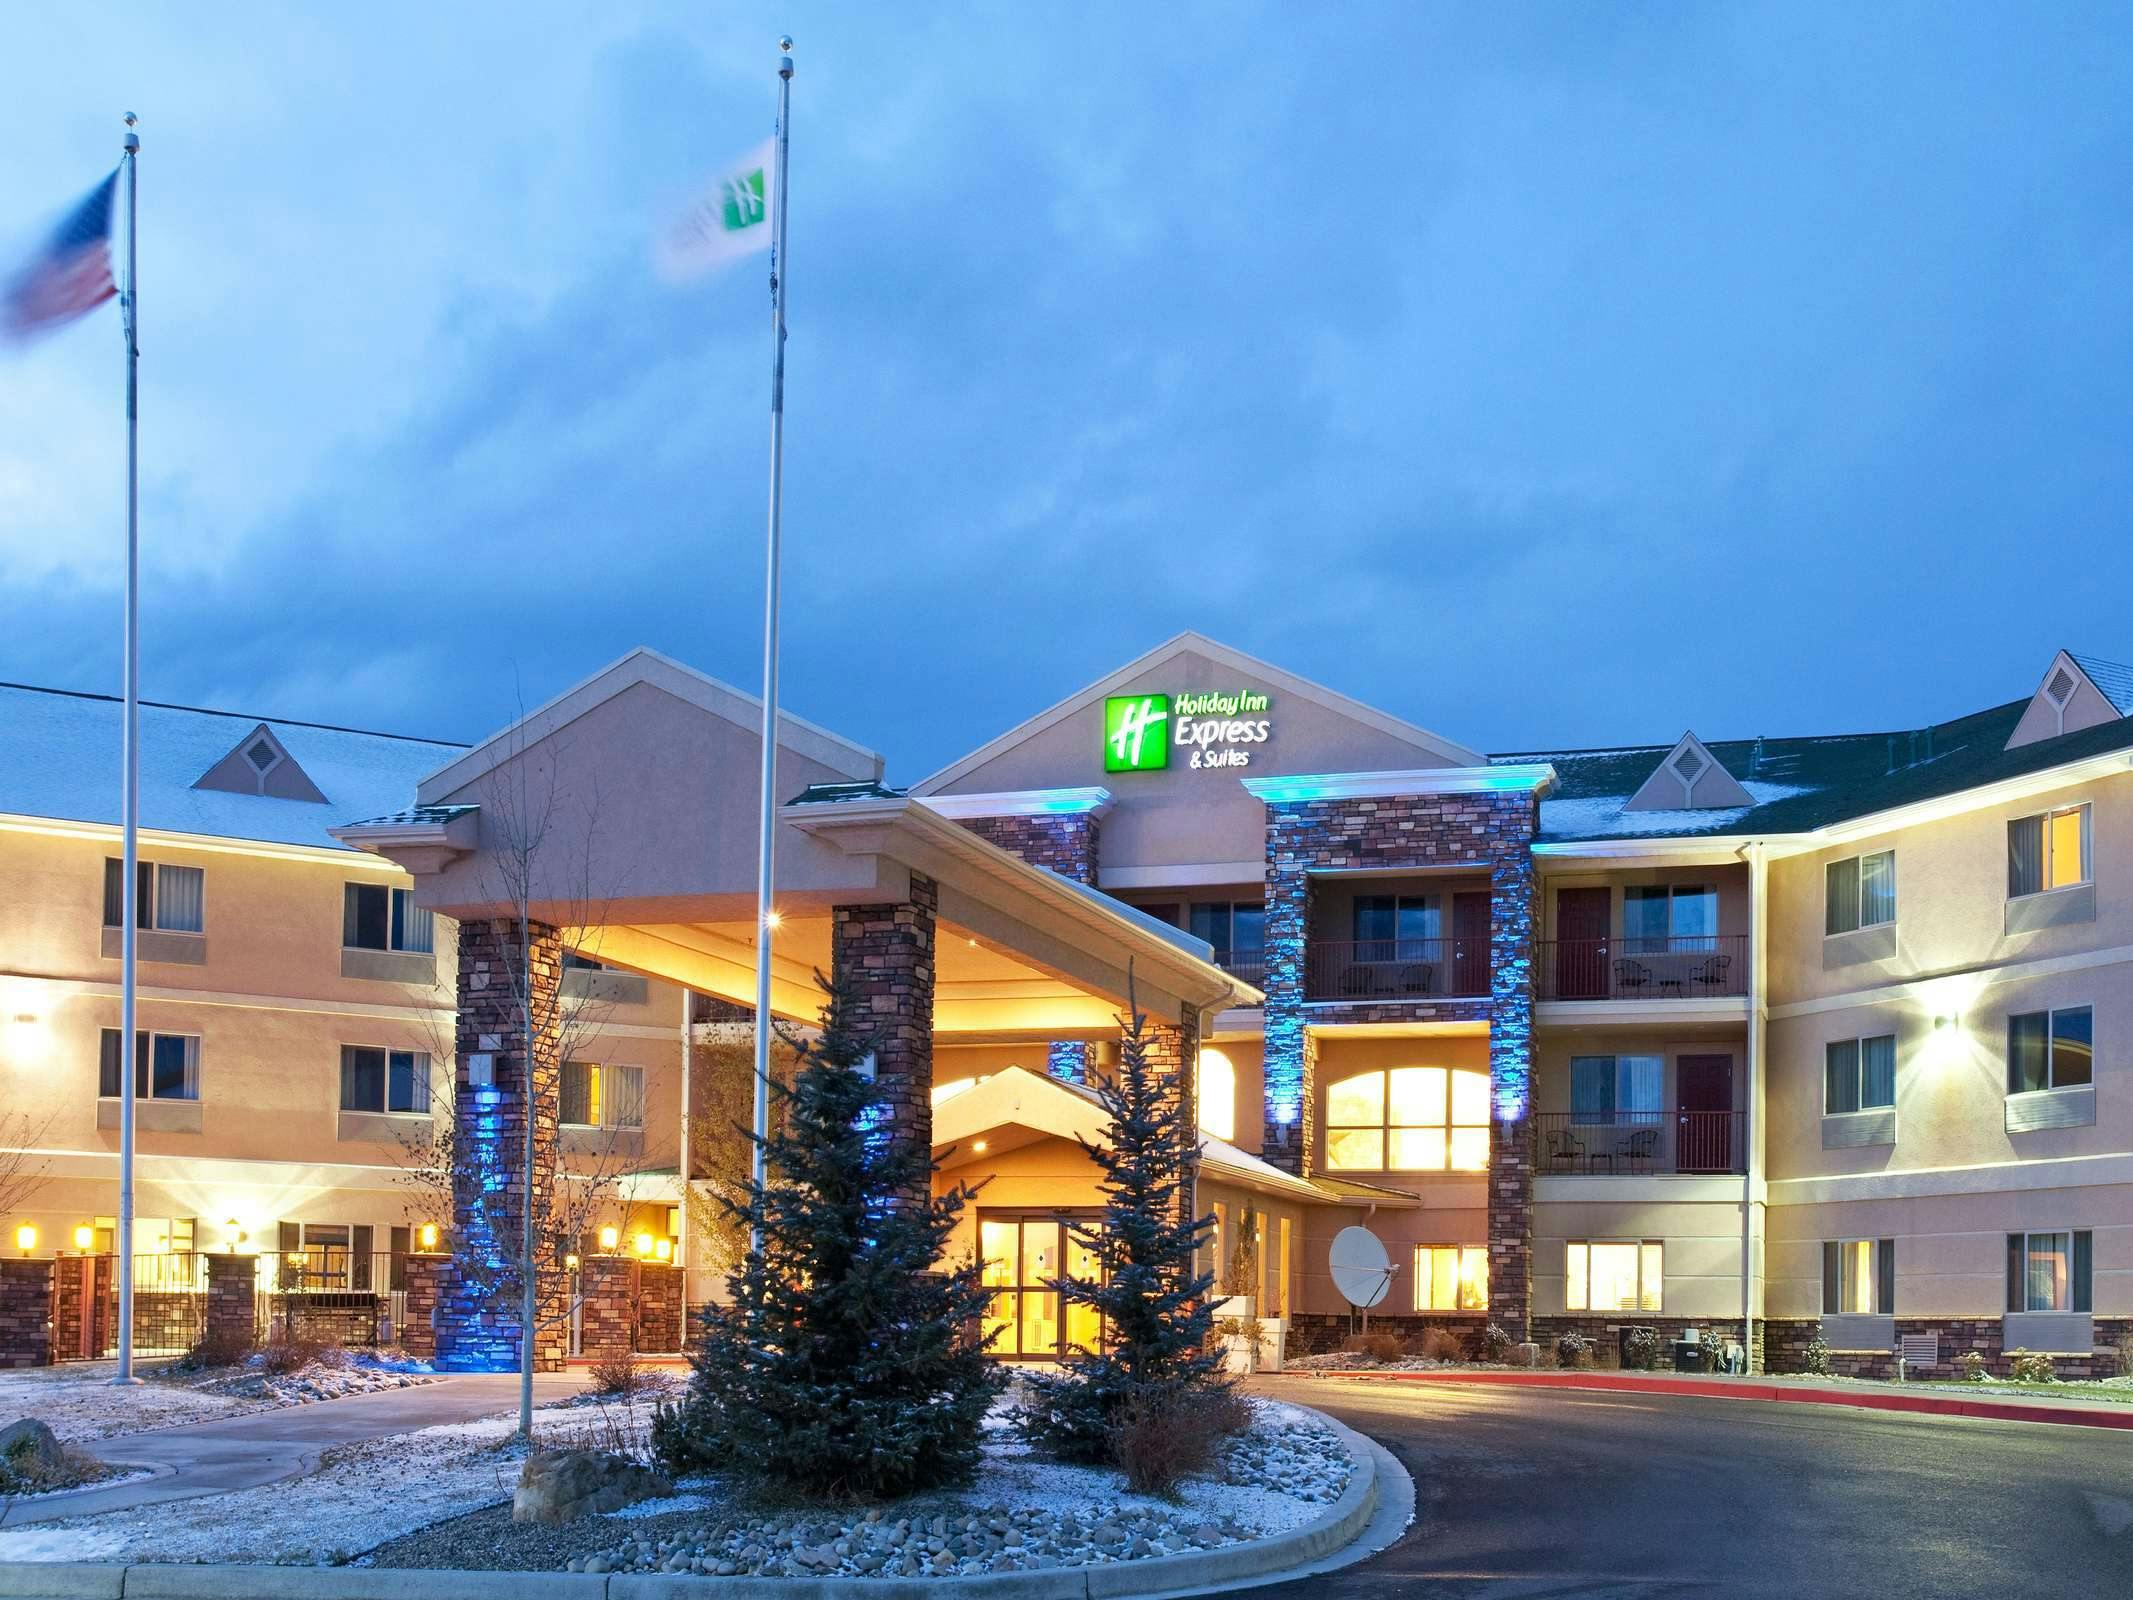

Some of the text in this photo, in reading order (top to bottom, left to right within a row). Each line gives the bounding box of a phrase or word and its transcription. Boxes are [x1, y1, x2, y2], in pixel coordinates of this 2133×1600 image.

[1175, 690, 1268, 715] Holiday Inn
[1174, 716, 1271, 750] Express
[1189, 749, 1250, 769] & Suites
